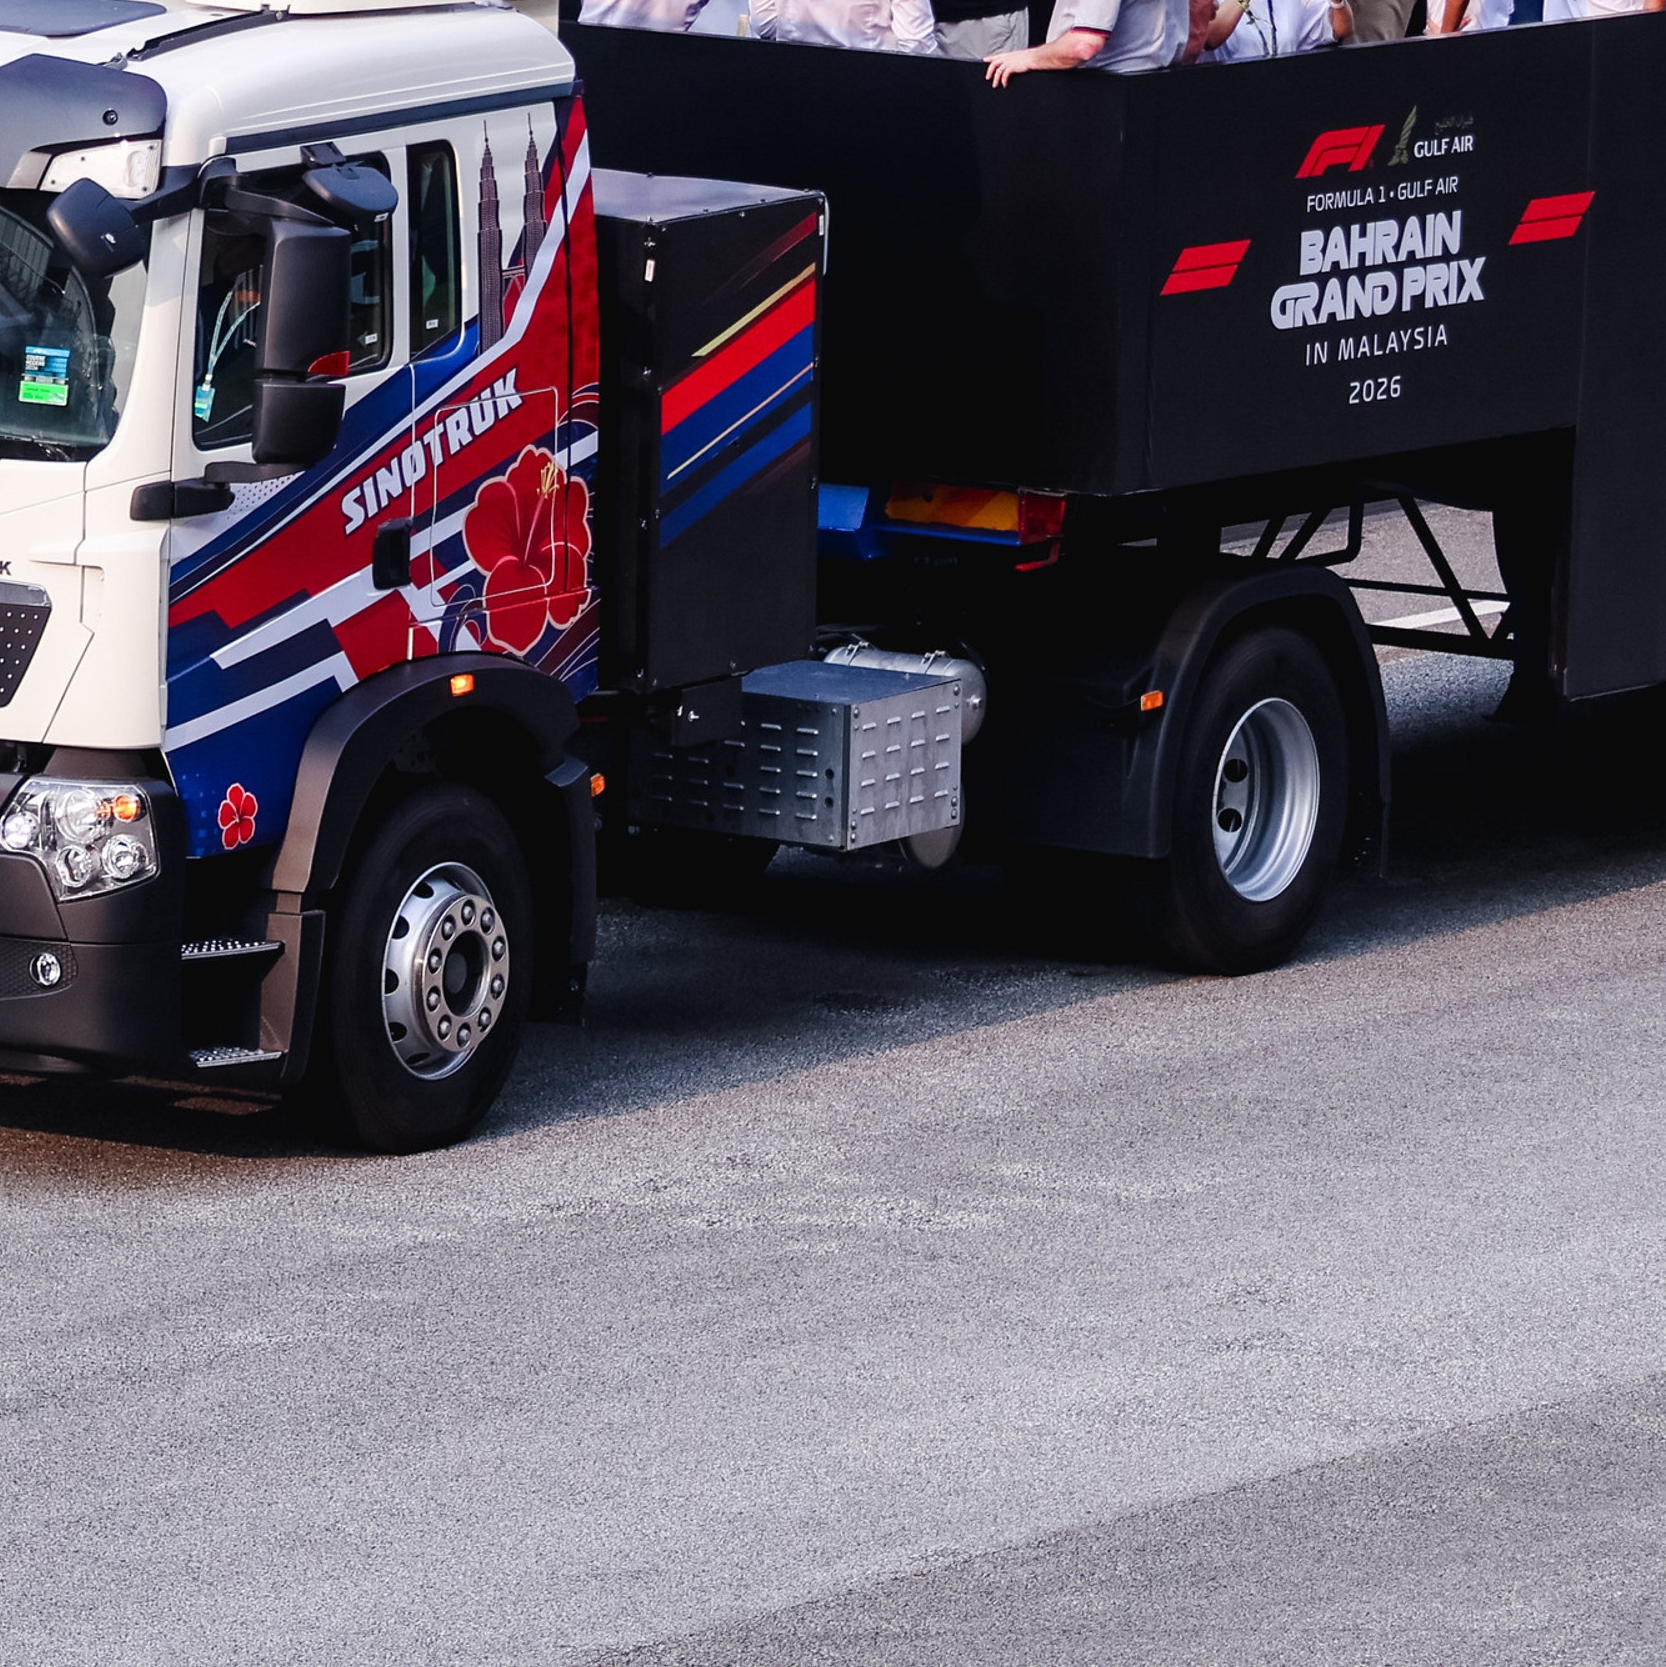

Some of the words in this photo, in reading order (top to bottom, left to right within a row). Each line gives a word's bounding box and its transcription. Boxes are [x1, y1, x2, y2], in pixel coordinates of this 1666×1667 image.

[1414, 137, 1449, 158] GULF
[1451, 135, 1473, 154] AIR
[1307, 187, 1374, 213] FORMULA
[1378, 185, 1387, 206] 1
[1397, 180, 1432, 201] GULF
[1435, 175, 1458, 195] AIR
[1299, 210, 1462, 276] BAHRAIN
[1271, 271, 1397, 330] GRAND
[1402, 257, 1487, 312] PRIX
[1305, 341, 1328, 366] IN
[1338, 323, 1448, 362] MALAYSIA
[1348, 375, 1402, 405] 2026
[341, 369, 523, 536] SINOTRUK
